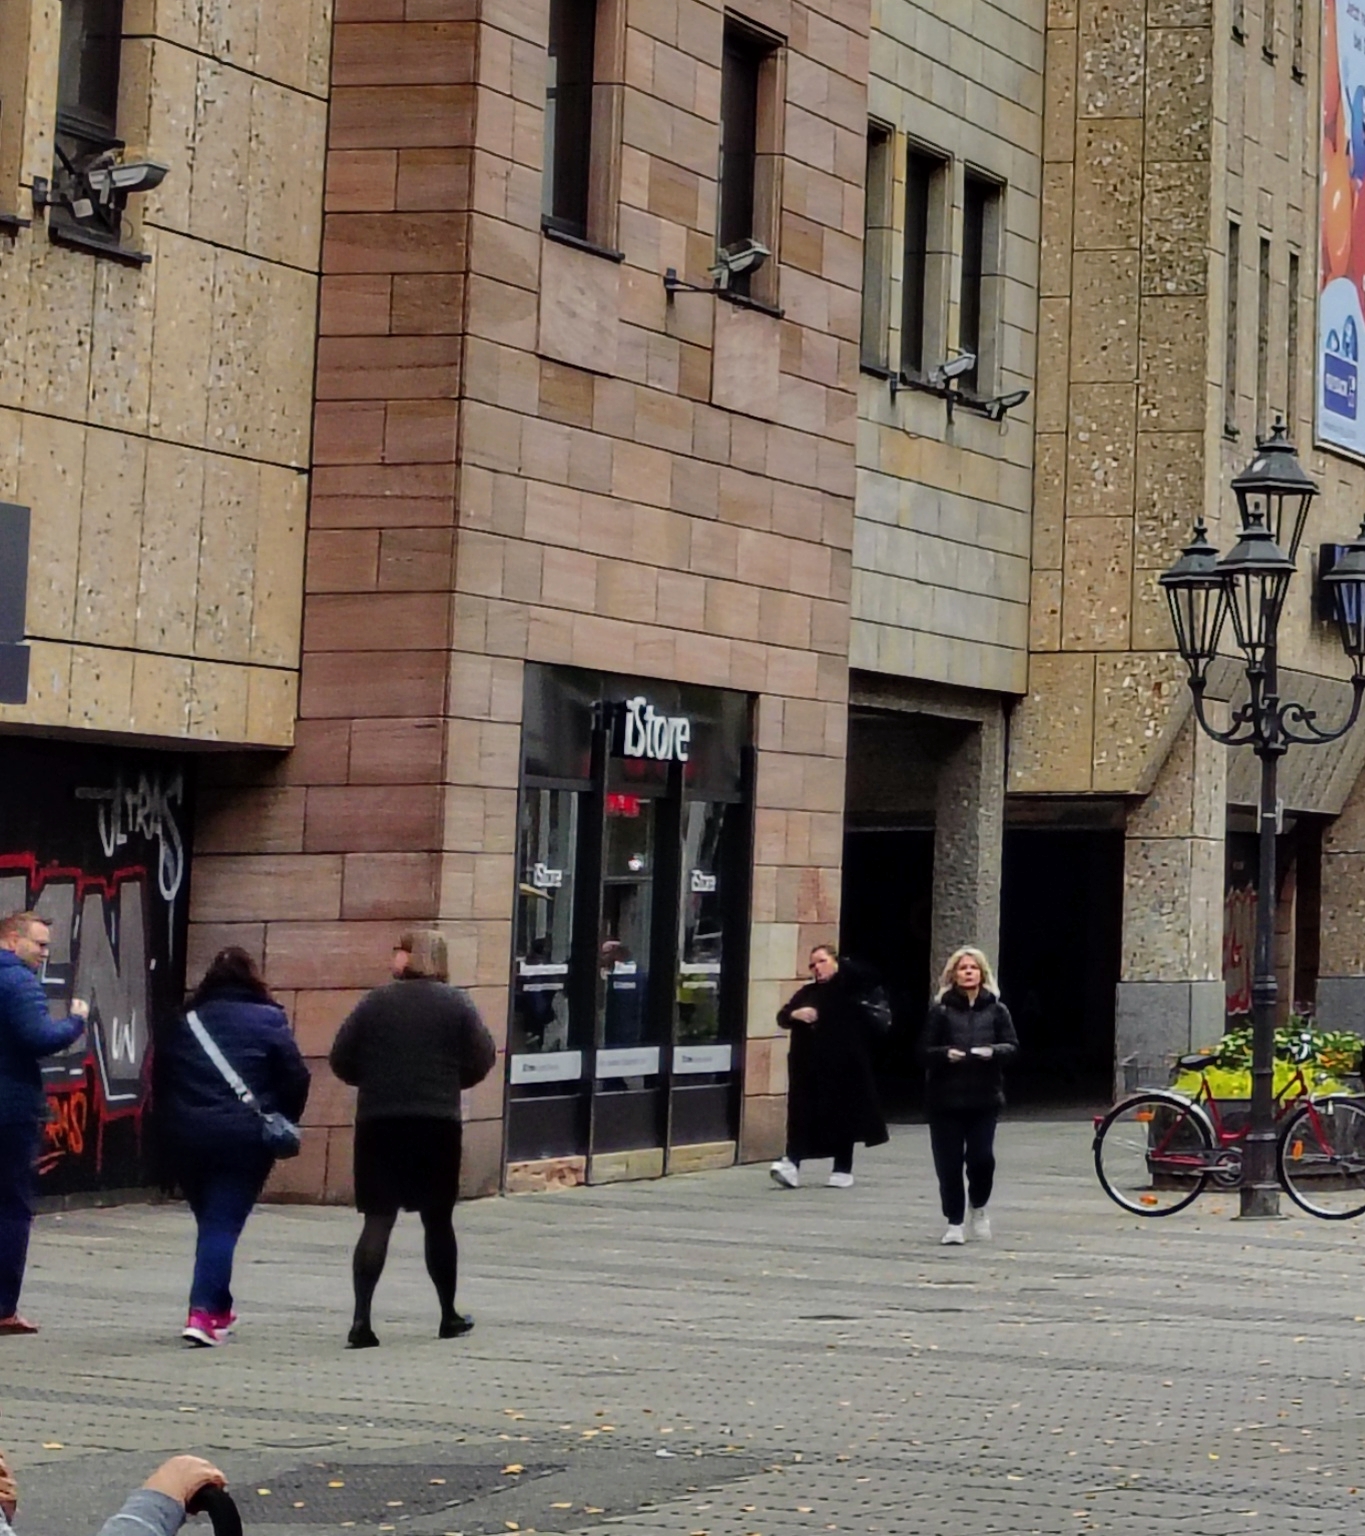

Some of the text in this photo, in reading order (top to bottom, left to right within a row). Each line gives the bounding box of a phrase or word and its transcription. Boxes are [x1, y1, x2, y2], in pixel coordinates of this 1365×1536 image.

[624, 696, 690, 762] iStore
[533, 862, 563, 888] iStore
[690, 869, 717, 893] iStore
